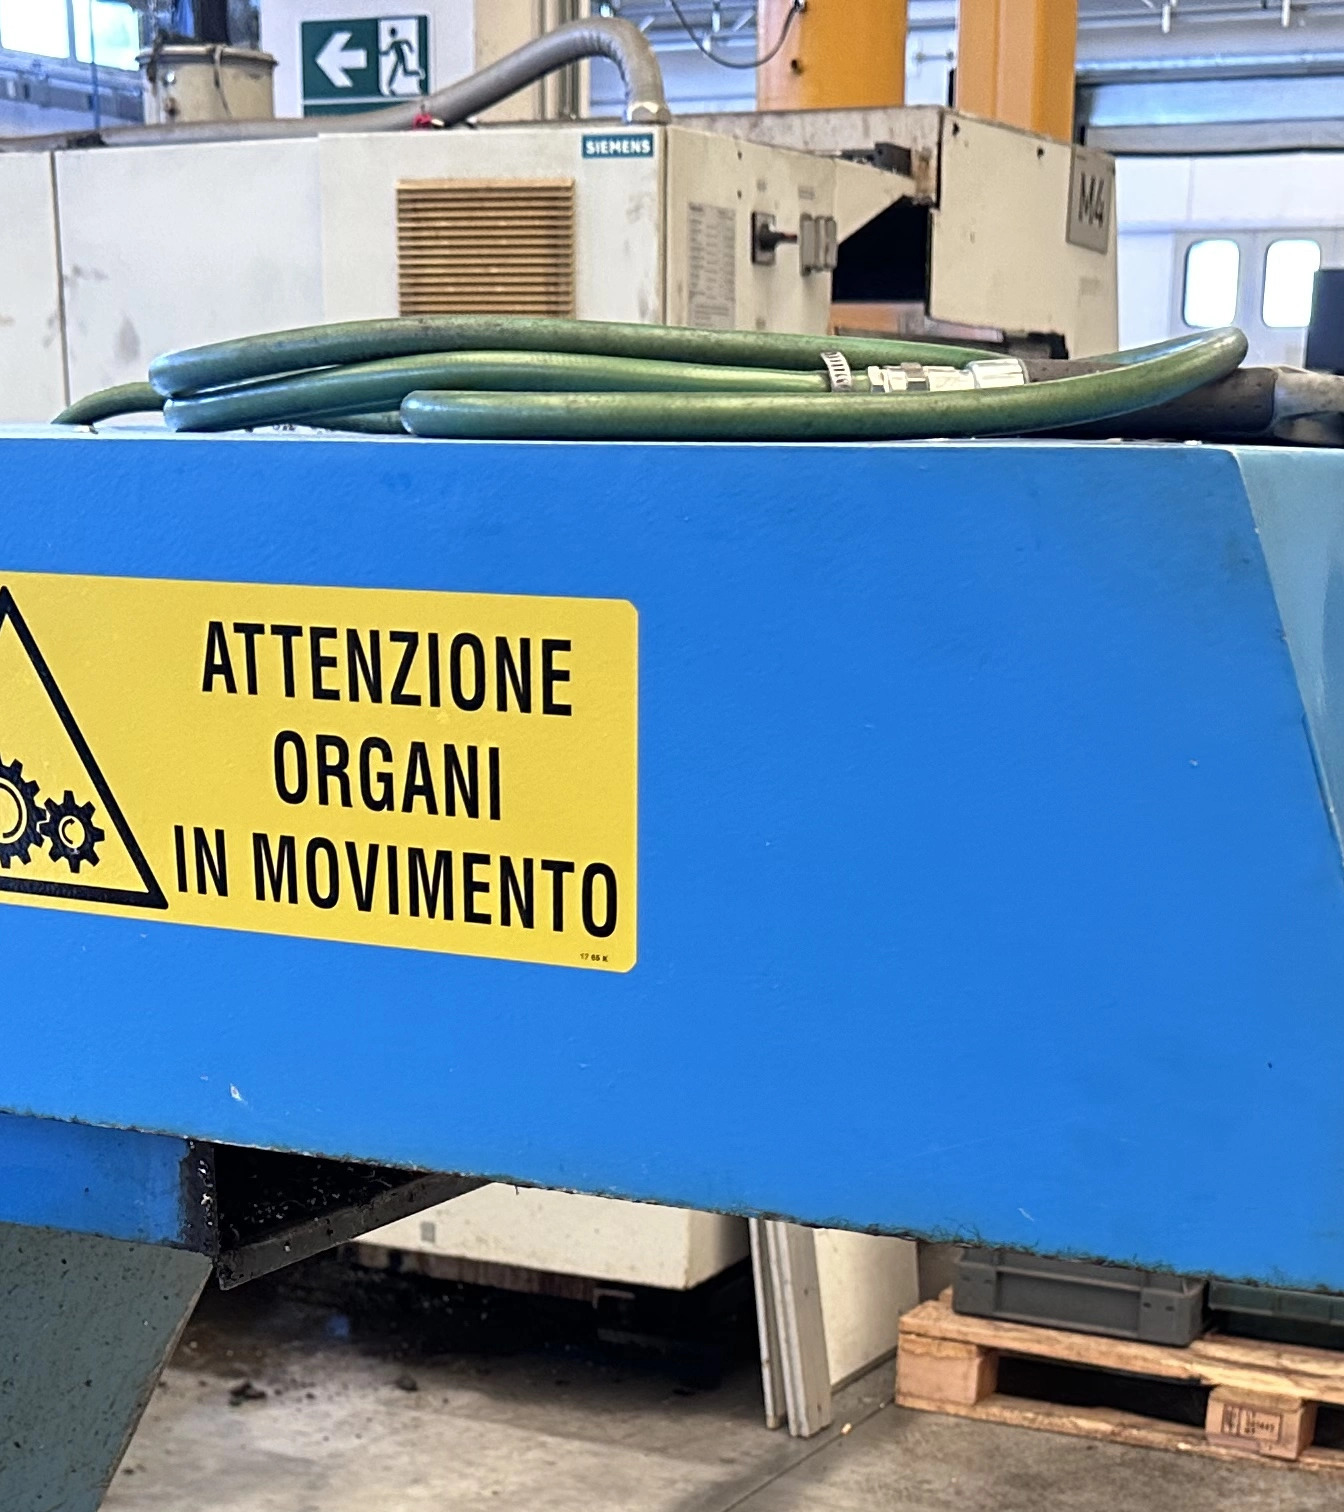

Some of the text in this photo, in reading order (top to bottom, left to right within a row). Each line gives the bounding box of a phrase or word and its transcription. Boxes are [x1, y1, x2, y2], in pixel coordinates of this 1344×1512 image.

[585, 139, 651, 155] SIEMENS
[1078, 171, 1104, 228] M4
[202, 620, 572, 716] ATTENZIONE
[273, 730, 501, 820] ORGANI
[174, 824, 618, 938] IN MOVIMENTO
